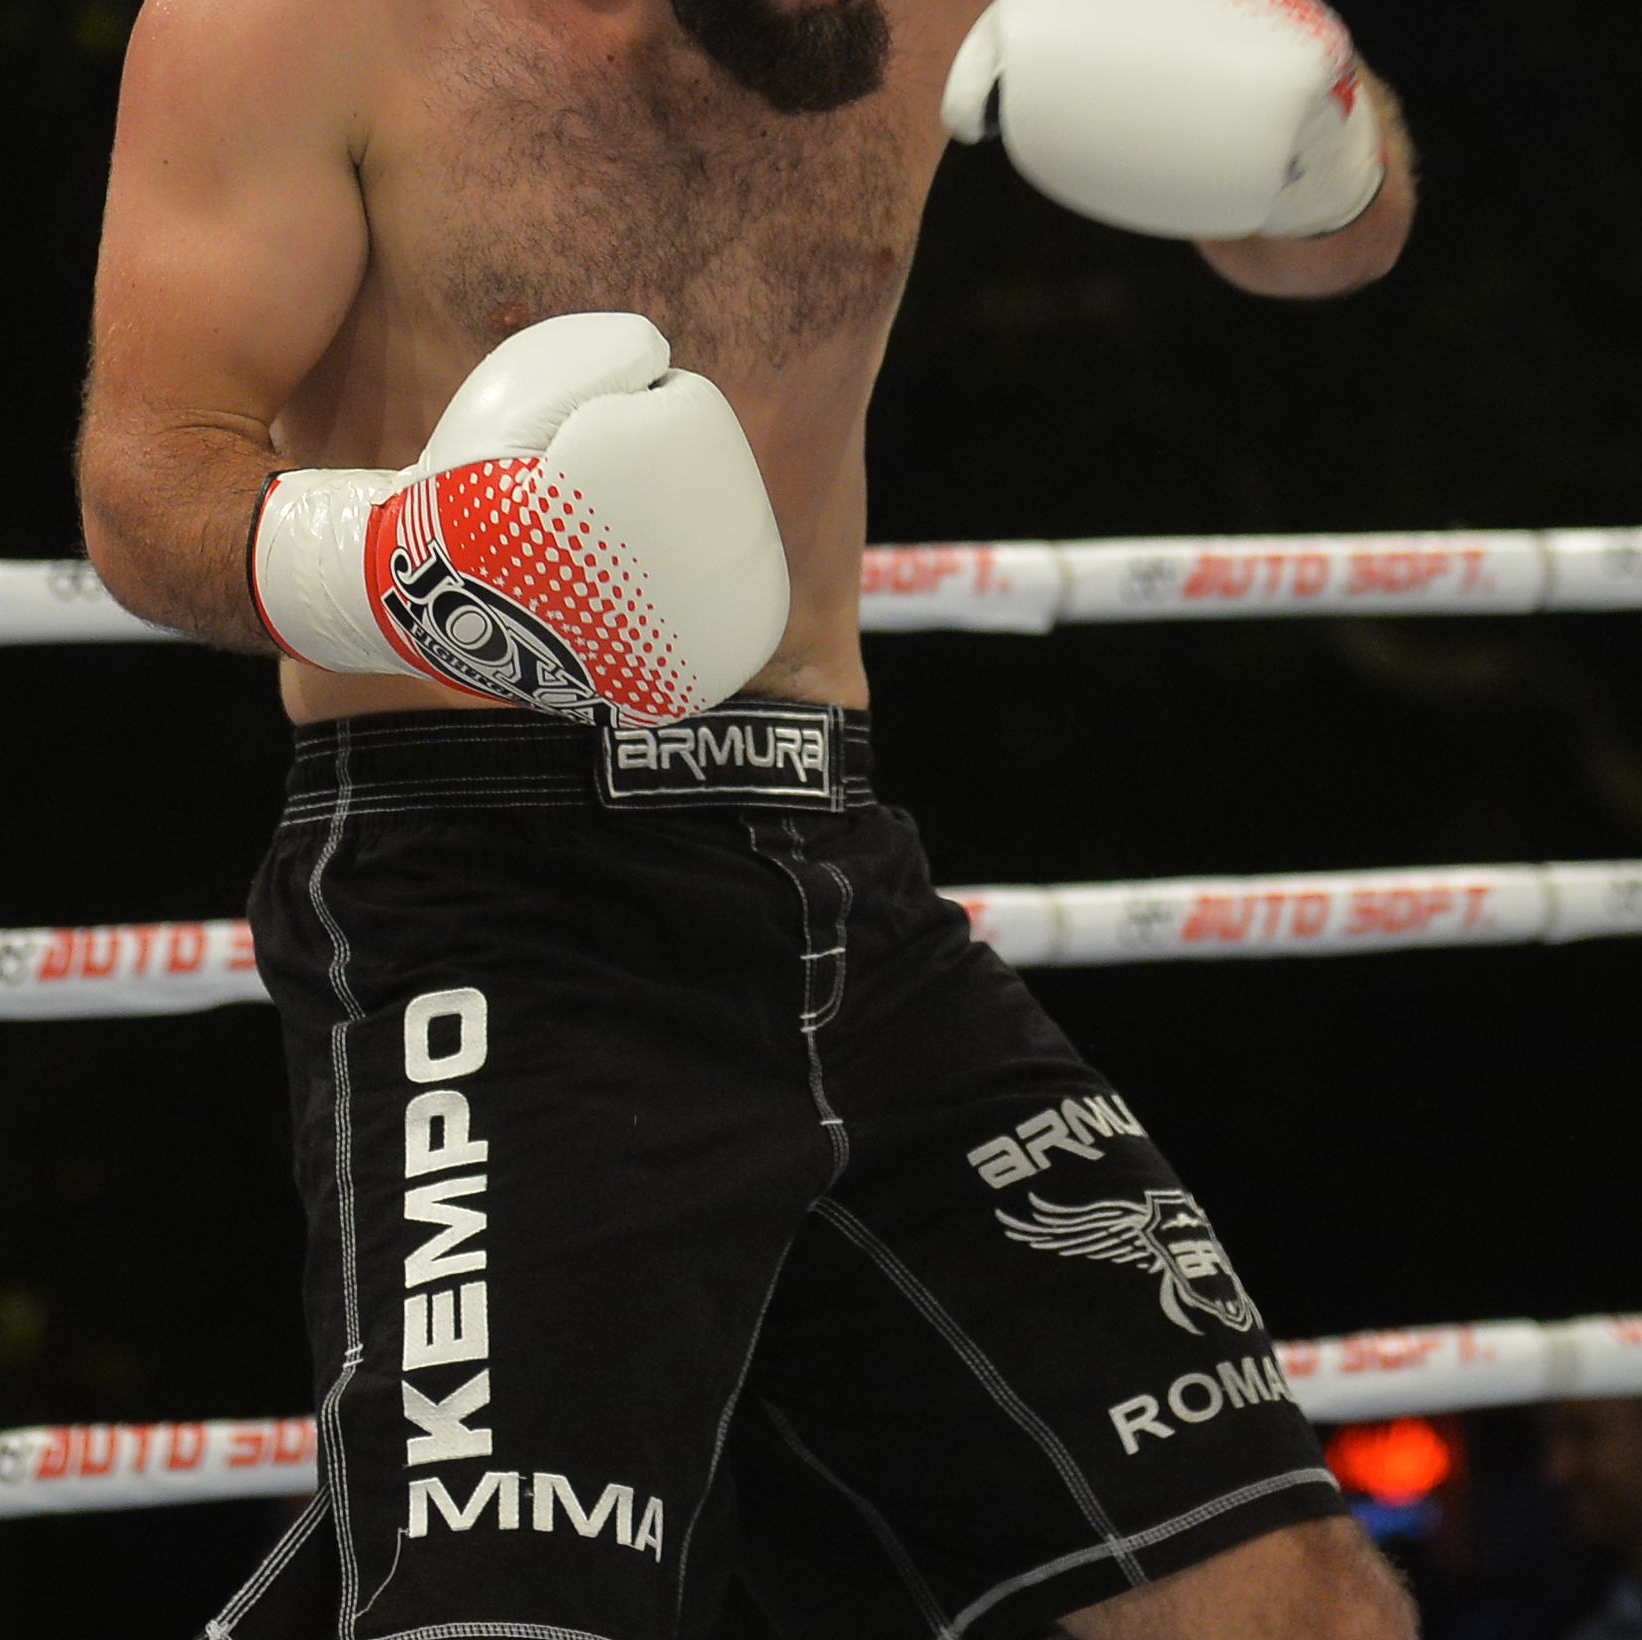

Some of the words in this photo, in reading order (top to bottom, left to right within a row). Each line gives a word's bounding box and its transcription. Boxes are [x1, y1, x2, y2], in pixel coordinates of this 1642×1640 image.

[1179, 552, 1331, 600] AUTO
[614, 725, 824, 783] ARMURA
[1179, 889, 1333, 943] AUTO
[37, 923, 208, 981] AUTO
[401, 986, 494, 1467] KEMPO
[35, 1422, 208, 1480] AUTO
[407, 1471, 664, 1564] MMA
